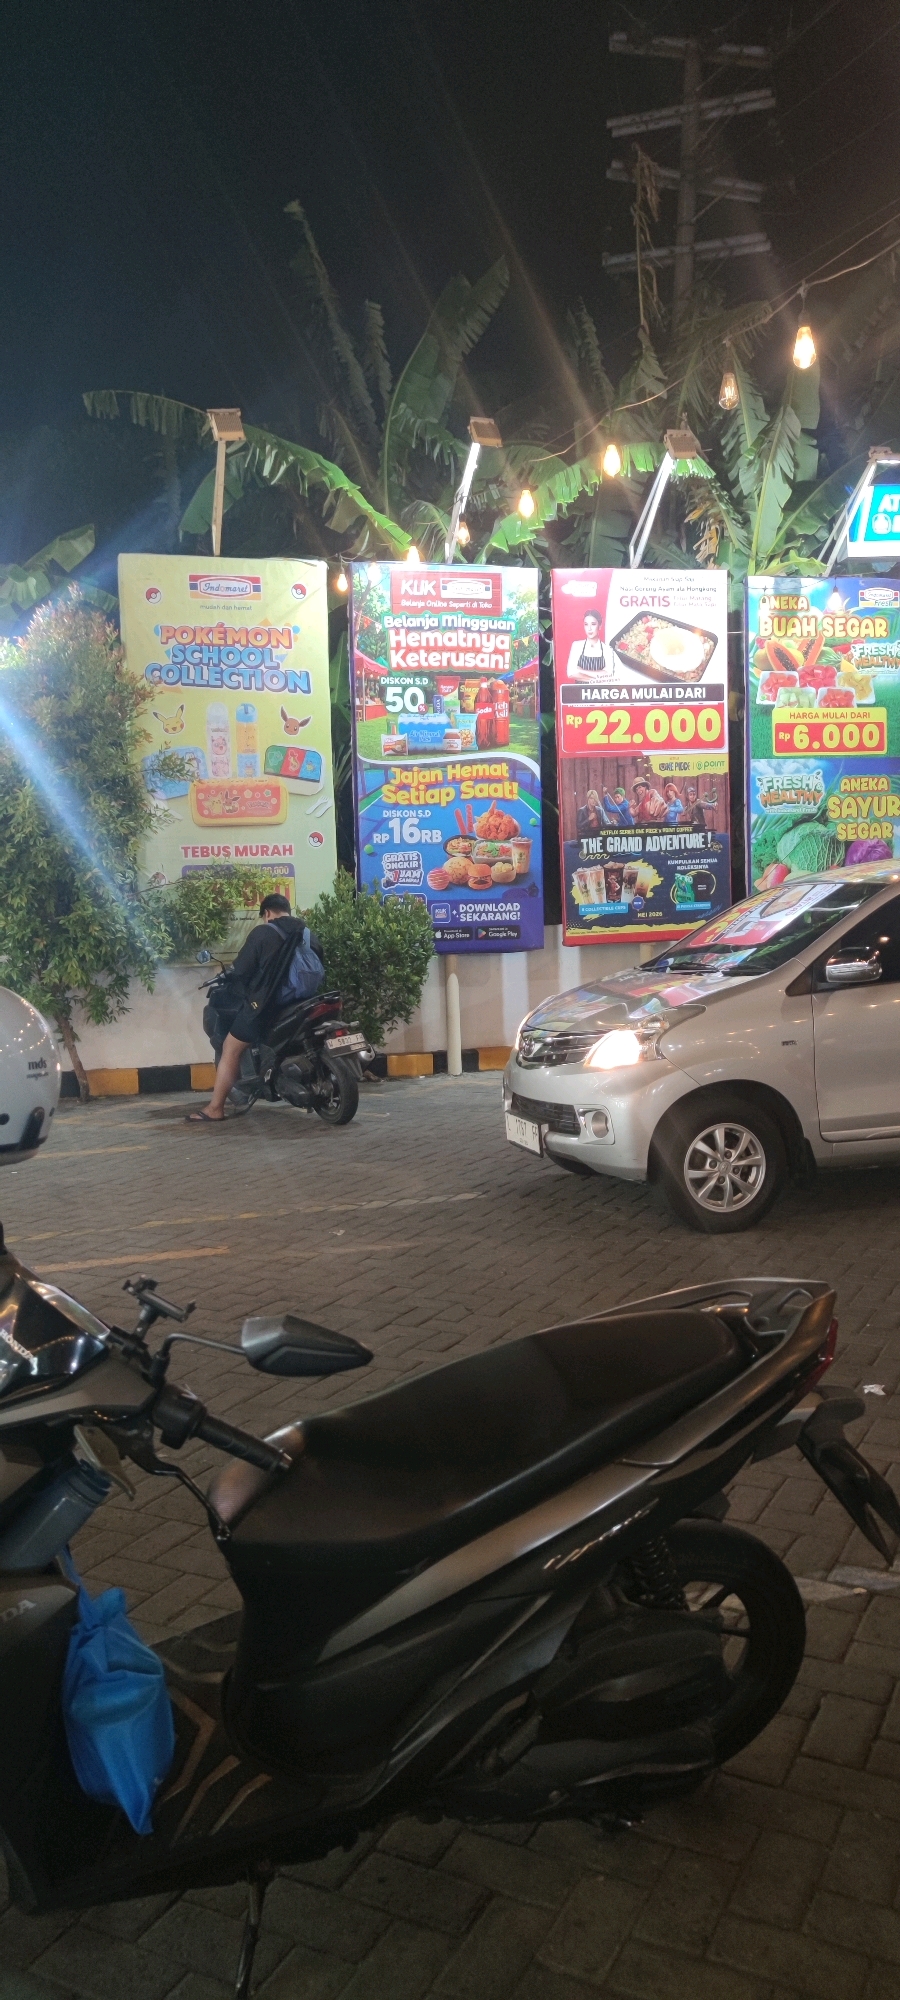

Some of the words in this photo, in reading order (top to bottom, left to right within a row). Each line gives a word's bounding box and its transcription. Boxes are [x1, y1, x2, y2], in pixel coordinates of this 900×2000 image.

[202, 582, 249, 593] Indomaret
[401, 579, 437, 596] KLIK
[401, 600, 426, 609] Belanja
[449, 601, 471, 610] Seperti
[472, 601, 479, 609] di
[479, 601, 493, 609] Toko
[620, 596, 671, 607] GRATIS
[761, 595, 810, 611] ANEKA
[383, 615, 439, 631] Belanja
[441, 615, 516, 632] Mingguan
[760, 616, 818, 638] BUAH
[822, 616, 889, 638] SEGAR
[160, 622, 293, 649] POKÉMON
[389, 629, 511, 654] Hematnya
[172, 645, 281, 670] SCHOOL
[858, 644, 895, 658] FRESH
[391, 651, 511, 671] Keterusan!
[145, 663, 312, 695] COLLECTION
[381, 677, 413, 685] DISKON
[415, 677, 429, 685] S.D
[386, 686, 425, 713] 50
[581, 688, 630, 700] HARGA
[632, 688, 673, 700] MULAI
[675, 687, 707, 699] DARI
[495, 701, 509, 711] Teh
[789, 712, 820, 720] HARGA
[566, 715, 583, 729] Rp
[586, 708, 722, 745] 22.000
[779, 732, 791, 742] Rp
[793, 724, 880, 750] 6.000
[674, 761, 691, 772] PIECE
[391, 767, 444, 787] Jajan
[447, 763, 510, 780] Hemat
[762, 775, 816, 791] FRESH
[841, 777, 889, 793] ANEKA
[381, 784, 456, 807] Setiap
[460, 781, 520, 801] Saat!
[761, 790, 824, 808] HEALTHY
[383, 810, 416, 818] DISKON
[417, 810, 432, 818] S.D
[828, 795, 900, 819] SAYUR
[373, 834, 390, 844] RP
[837, 822, 894, 841] SEGAR
[581, 838, 604, 853] THE
[607, 836, 643, 852] GRAND
[646, 833, 706, 852] ADVENTURE
[181, 846, 232, 858] TEBUS
[234, 845, 293, 858] MURAH
[385, 853, 419, 862] GRATIS
[385, 861, 419, 870] ONGKIR
[460, 903, 521, 913] DOWNLOAD
[460, 912, 521, 922] SEKARANG!
[28, 1057, 47, 1070] mds
